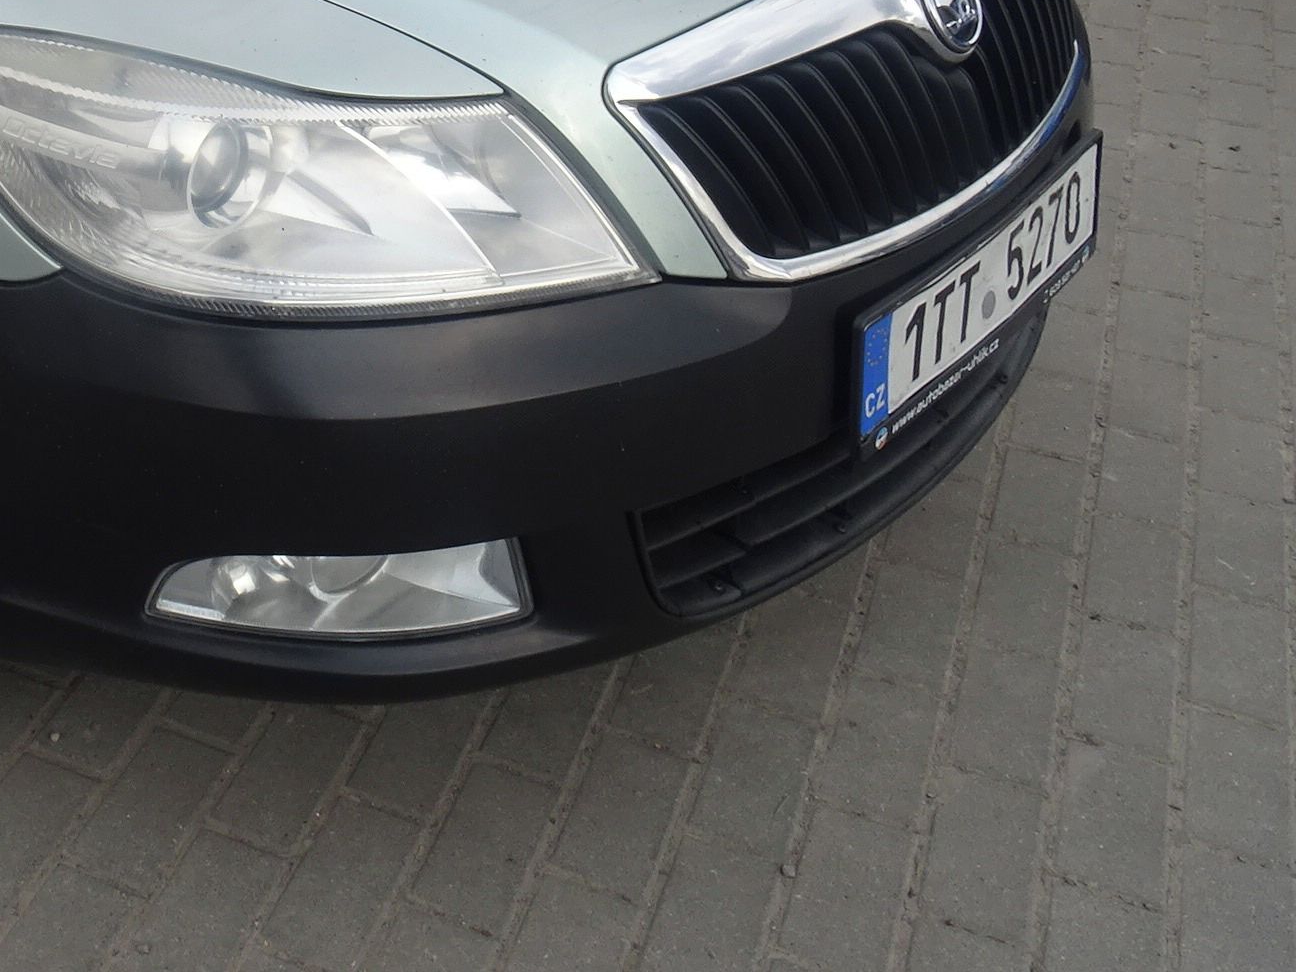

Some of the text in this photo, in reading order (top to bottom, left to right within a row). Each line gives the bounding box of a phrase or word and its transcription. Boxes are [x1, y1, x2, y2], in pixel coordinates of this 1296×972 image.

[904, 171, 1081, 381] 1TT 5270
[865, 383, 885, 418] CZ
